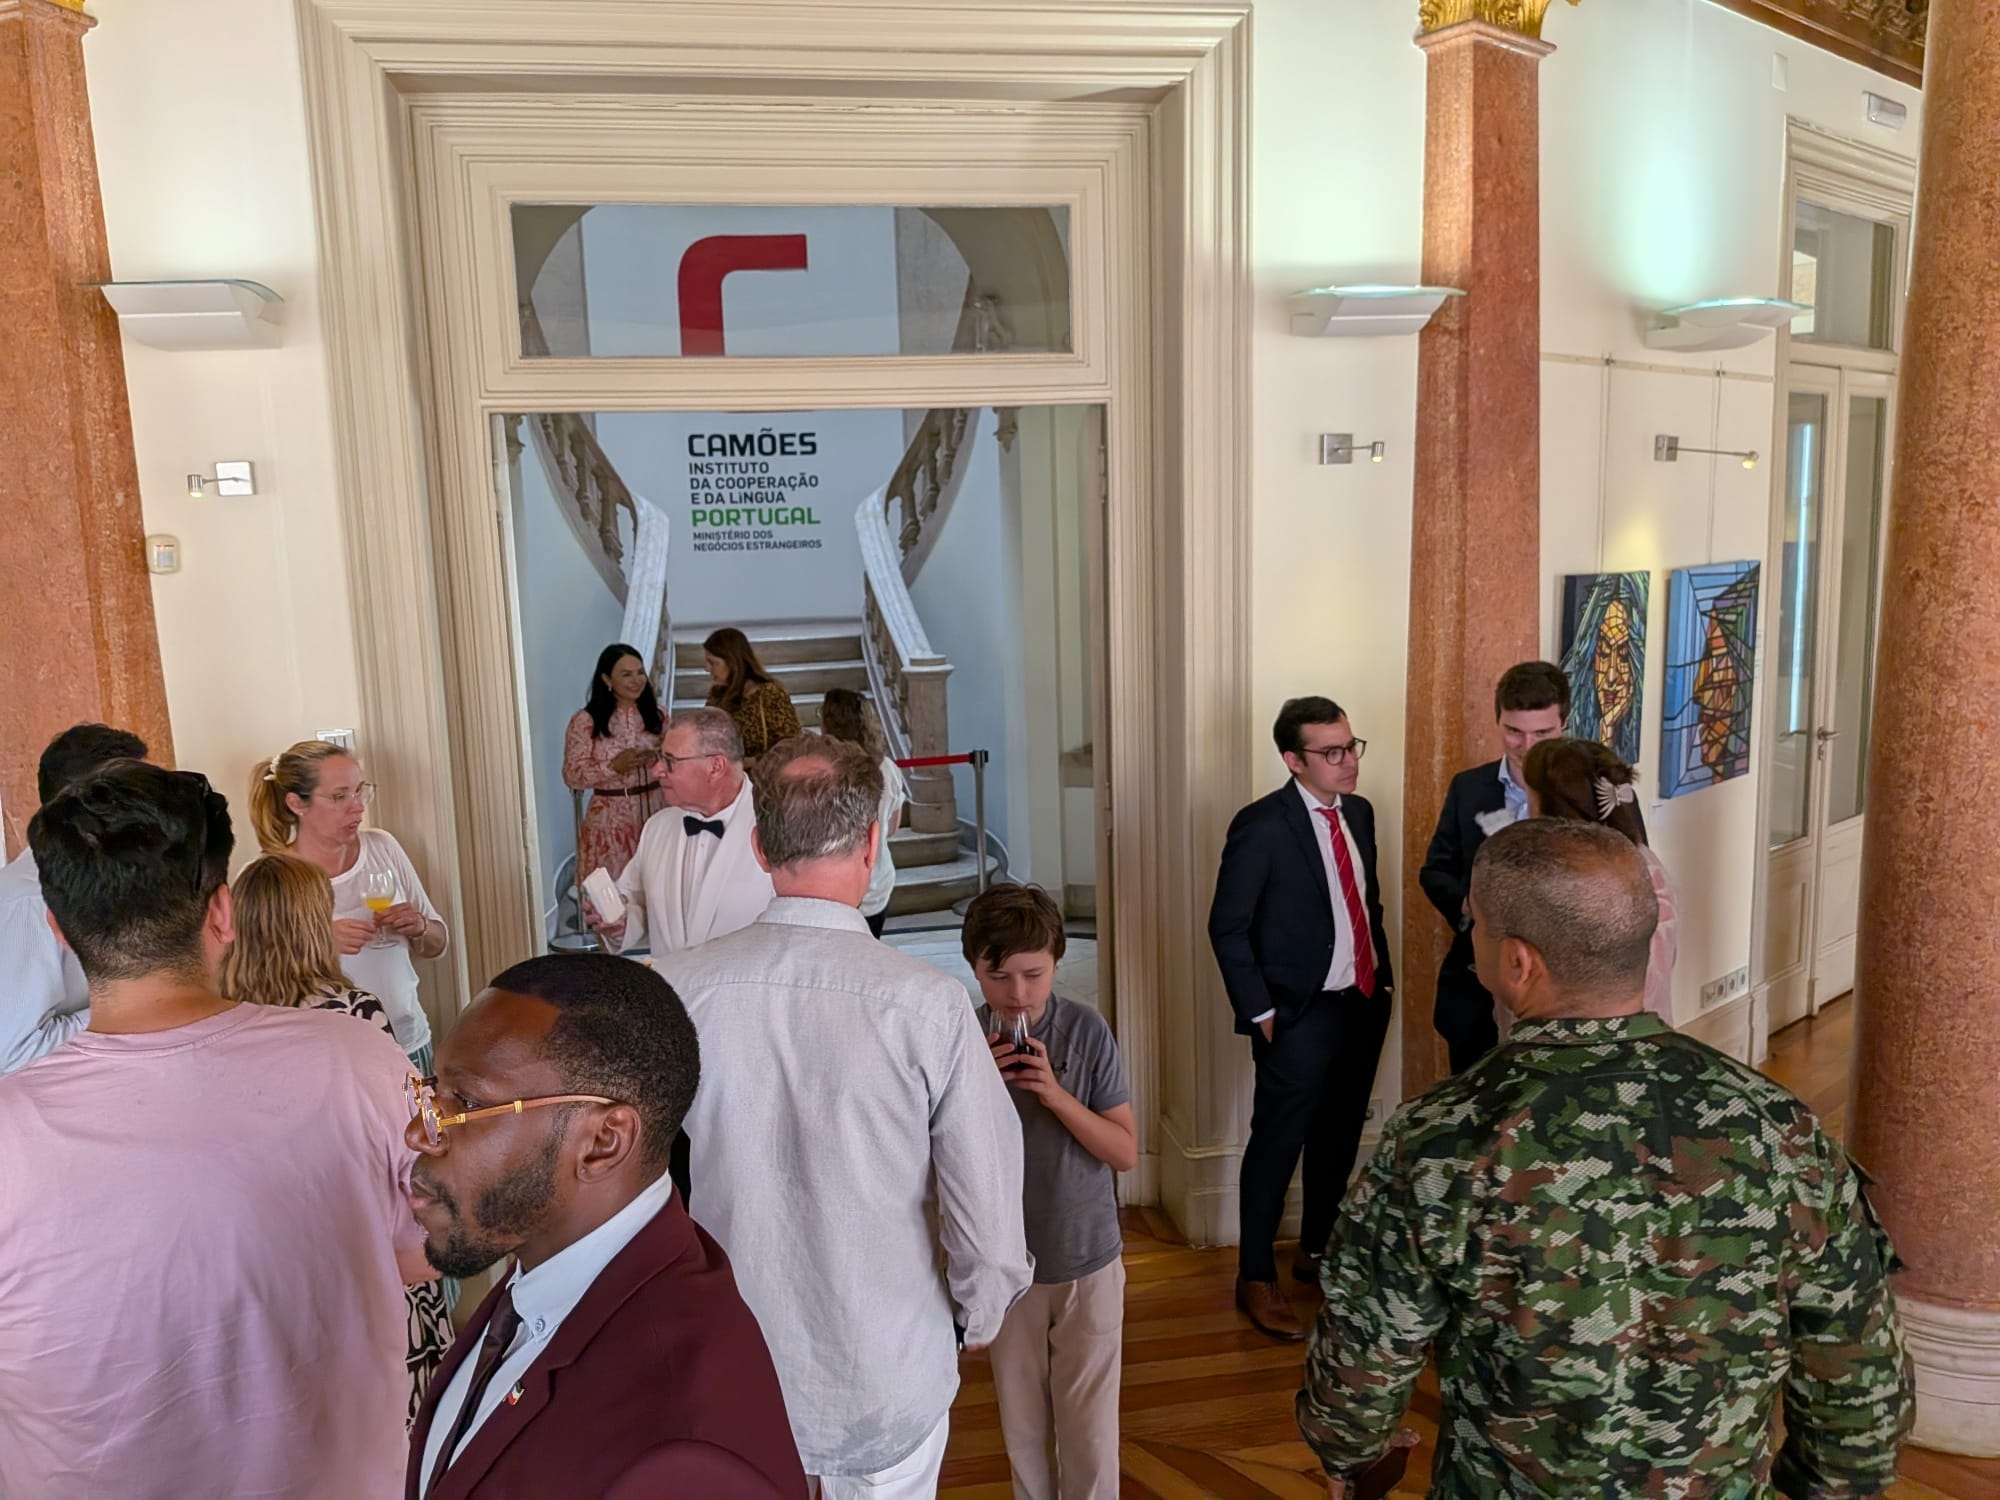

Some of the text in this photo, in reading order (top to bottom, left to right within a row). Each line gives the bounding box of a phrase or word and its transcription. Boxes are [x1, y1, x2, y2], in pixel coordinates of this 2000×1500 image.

[688, 427, 817, 457] CAMÕES
[689, 462, 770, 475] INSTITUTO
[690, 472, 819, 490] DA COOPERAÇÃO
[691, 492, 700, 504] E
[704, 492, 725, 504] DA
[691, 507, 821, 527] PORTUGAL
[693, 530, 773, 540] MINISTÉRIO DOS
[693, 539, 822, 552] NEGÓCIOS ESTRANGEIROS
